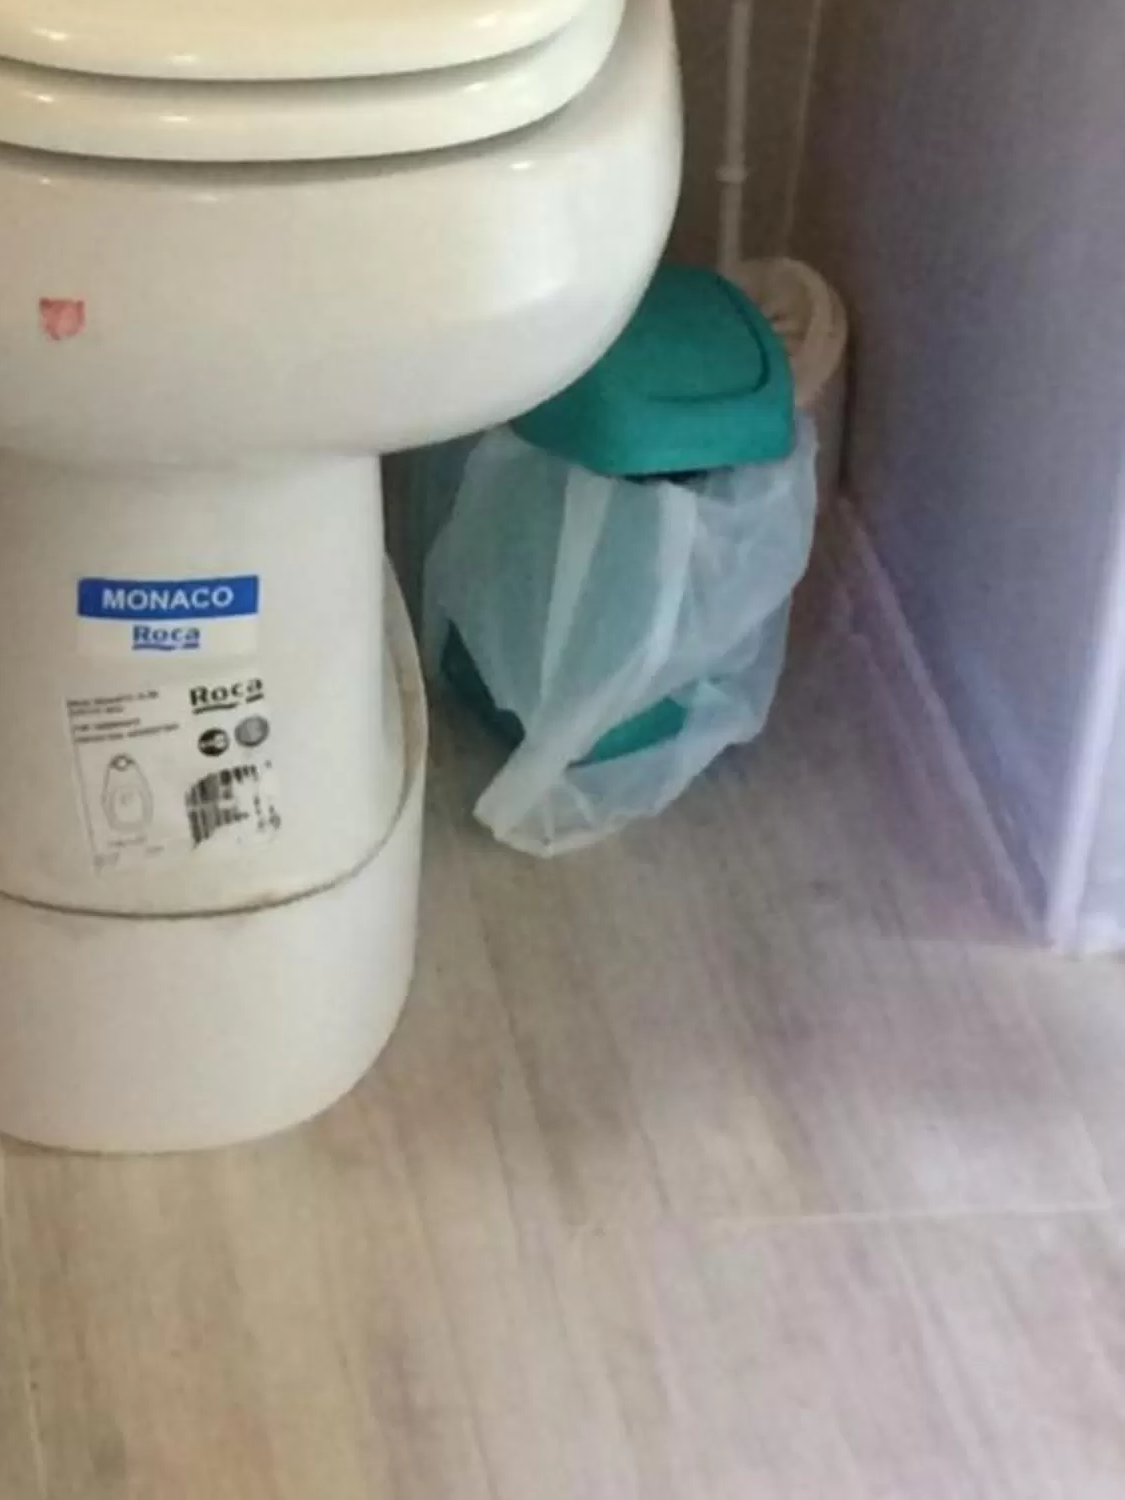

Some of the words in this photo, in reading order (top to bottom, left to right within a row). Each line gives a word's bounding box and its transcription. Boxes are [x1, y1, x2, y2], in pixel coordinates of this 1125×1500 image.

[101, 586, 235, 611] MONACO
[132, 625, 201, 645] Roca
[189, 677, 264, 709] Roca
